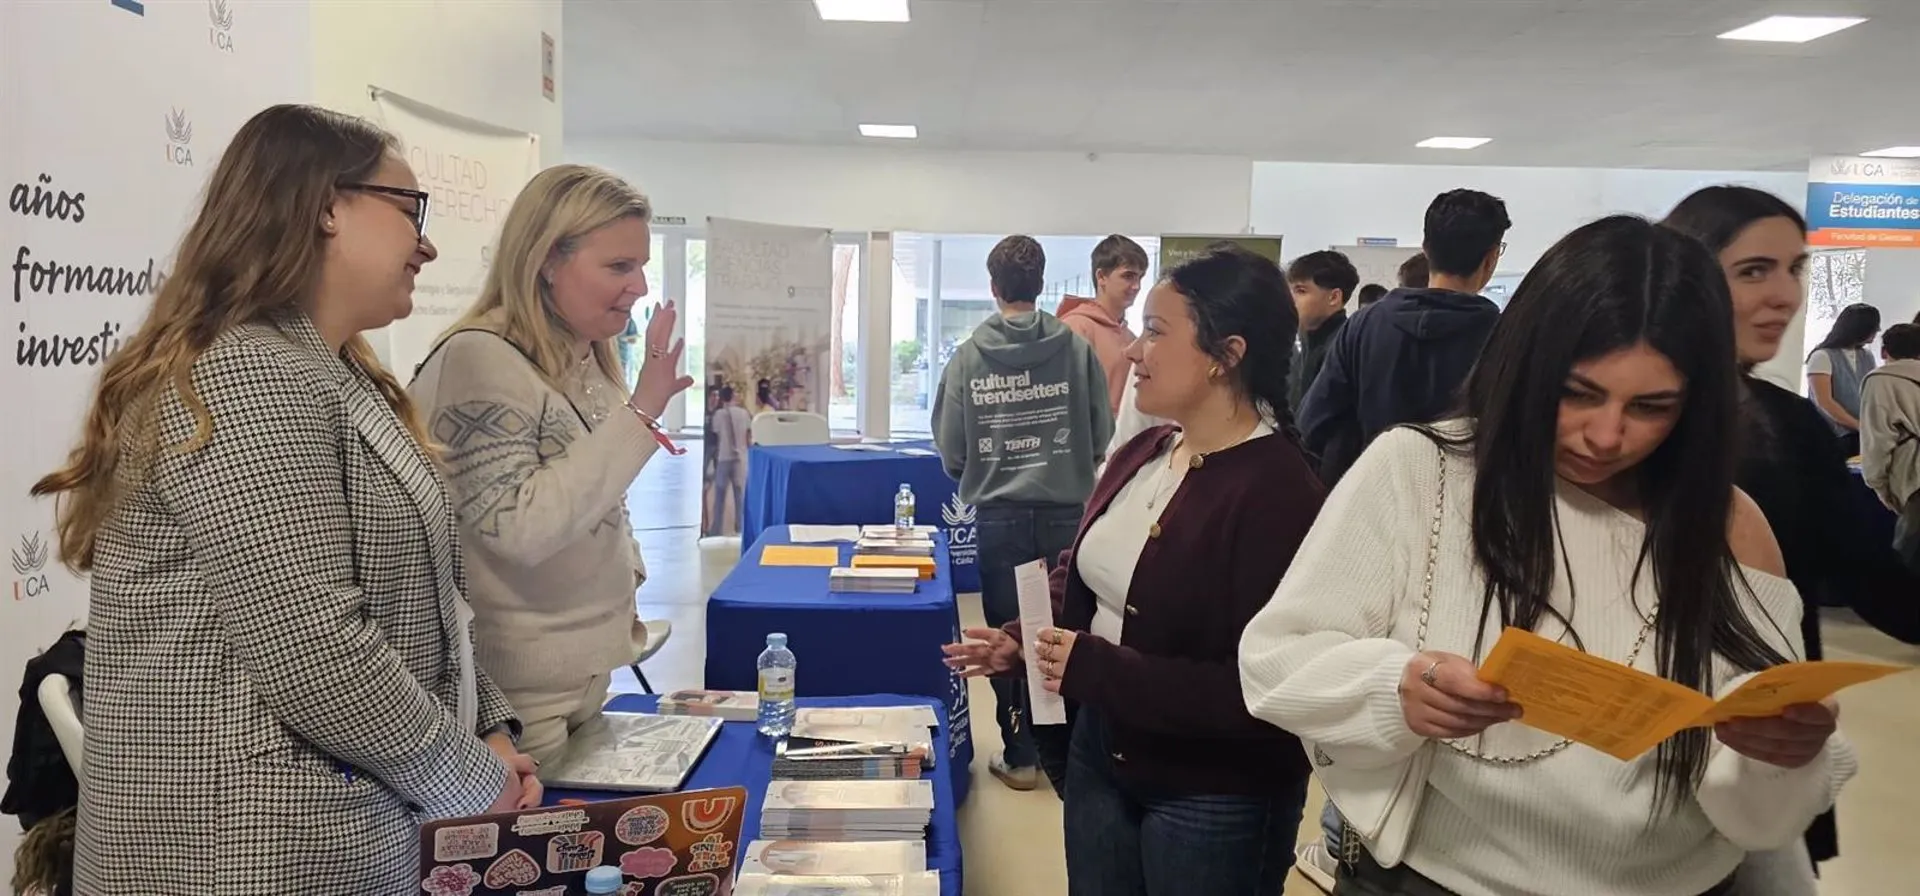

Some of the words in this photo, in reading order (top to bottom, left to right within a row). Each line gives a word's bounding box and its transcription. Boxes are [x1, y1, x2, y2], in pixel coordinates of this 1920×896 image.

[410, 146, 488, 191] CULTAD
[9, 172, 86, 223] años
[1833, 190, 1904, 207] Delegación
[1828, 203, 1920, 220] Estudiantes
[17, 321, 124, 367] investi
[970, 370, 1031, 391] cultural
[972, 381, 1070, 406] trendsetters
